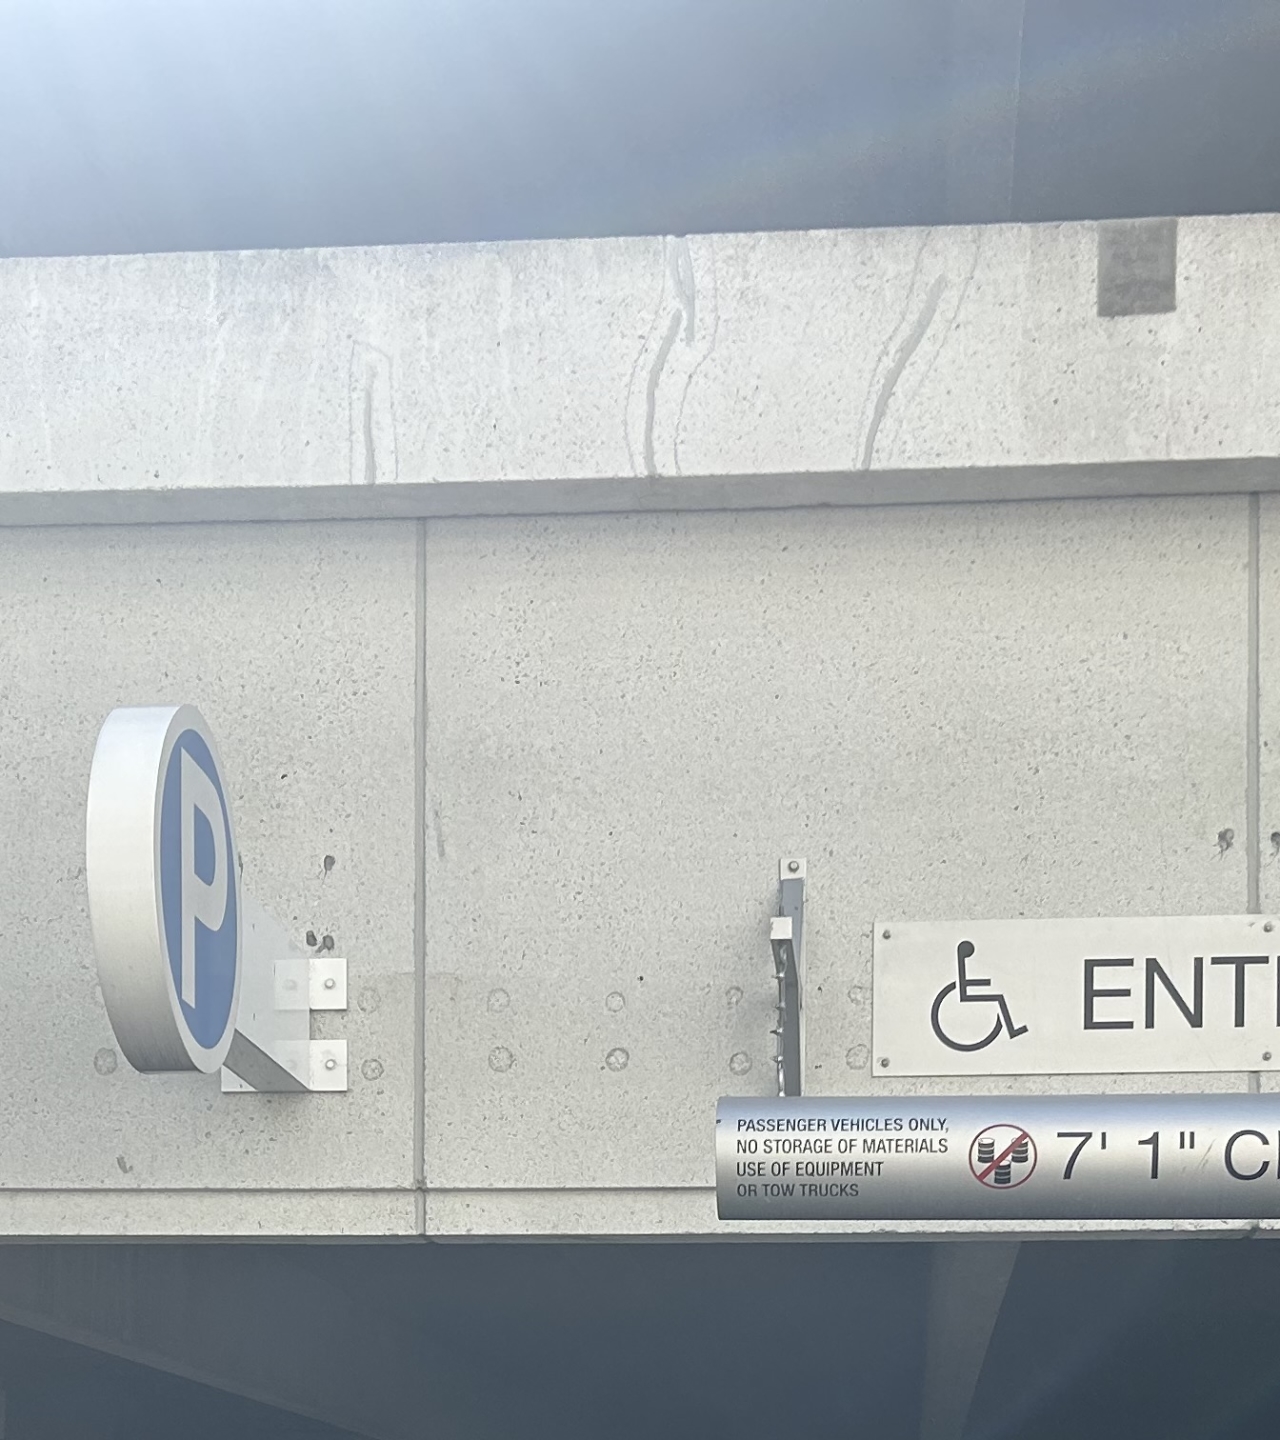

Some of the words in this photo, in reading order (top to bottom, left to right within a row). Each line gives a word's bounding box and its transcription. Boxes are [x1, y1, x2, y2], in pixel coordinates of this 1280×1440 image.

[180, 745, 229, 1009] P
[737, 1118, 827, 1132] PASSENGER
[830, 1118, 904, 1132] VEHICLES
[908, 1117, 950, 1134] ONLY,
[736, 1139, 758, 1154] NO
[763, 1138, 833, 1154] STORAGE
[837, 1138, 858, 1154] OF
[862, 1138, 949, 1154] MATERIALS
[1056, 1130, 1109, 1181] 7'
[1136, 1130, 1196, 1181] 1"
[736, 1161, 766, 1177] USE
[771, 1161, 791, 1177] OF
[795, 1161, 885, 1177] EQUIPMENT
[736, 1183, 758, 1198] OR
[762, 1183, 795, 1197] TOW
[799, 1183, 860, 1197] TRUCKS
